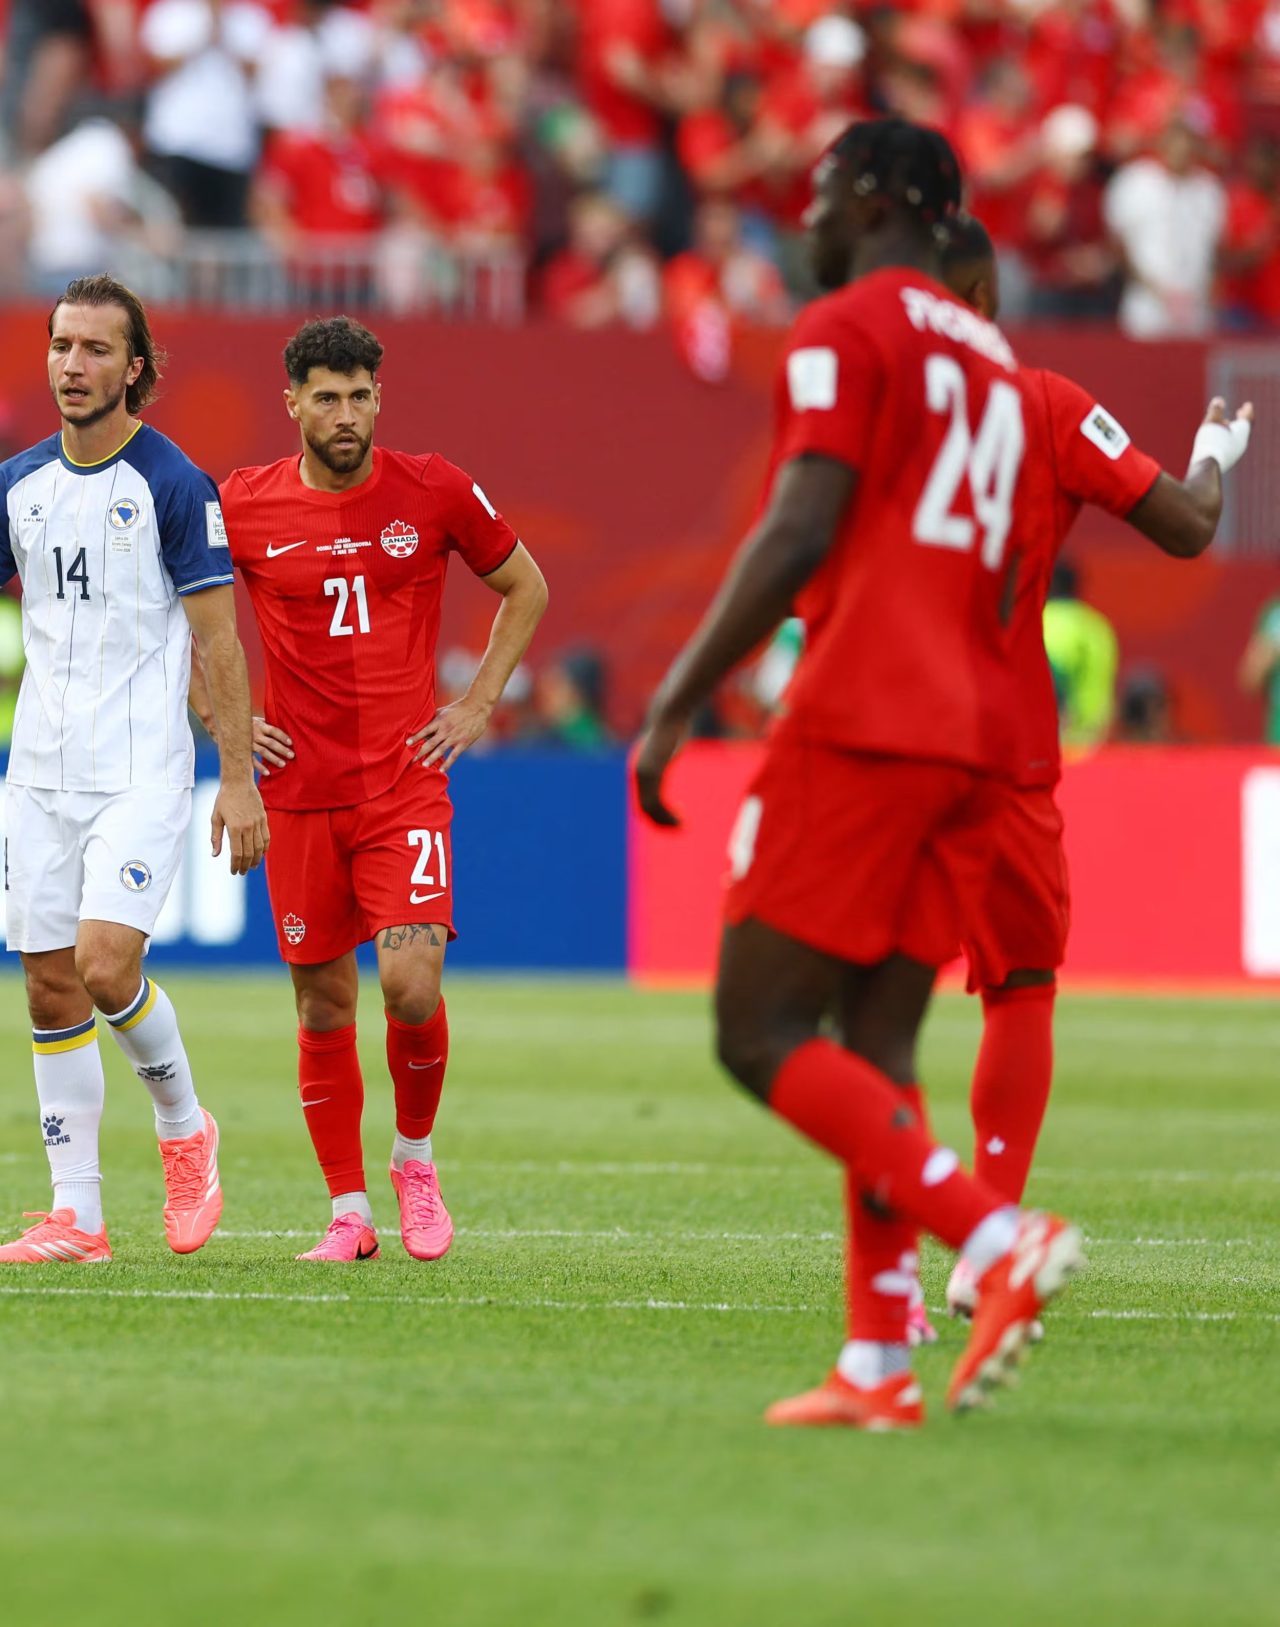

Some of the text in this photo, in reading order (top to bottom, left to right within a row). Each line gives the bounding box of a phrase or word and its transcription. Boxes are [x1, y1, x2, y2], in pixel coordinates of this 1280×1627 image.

[912, 353, 1025, 570] 24
[382, 536, 417, 544] CANADA
[53, 546, 90, 600] 14
[323, 575, 371, 637] 21
[407, 829, 447, 888] 21
[43, 1134, 71, 1146] KELME
